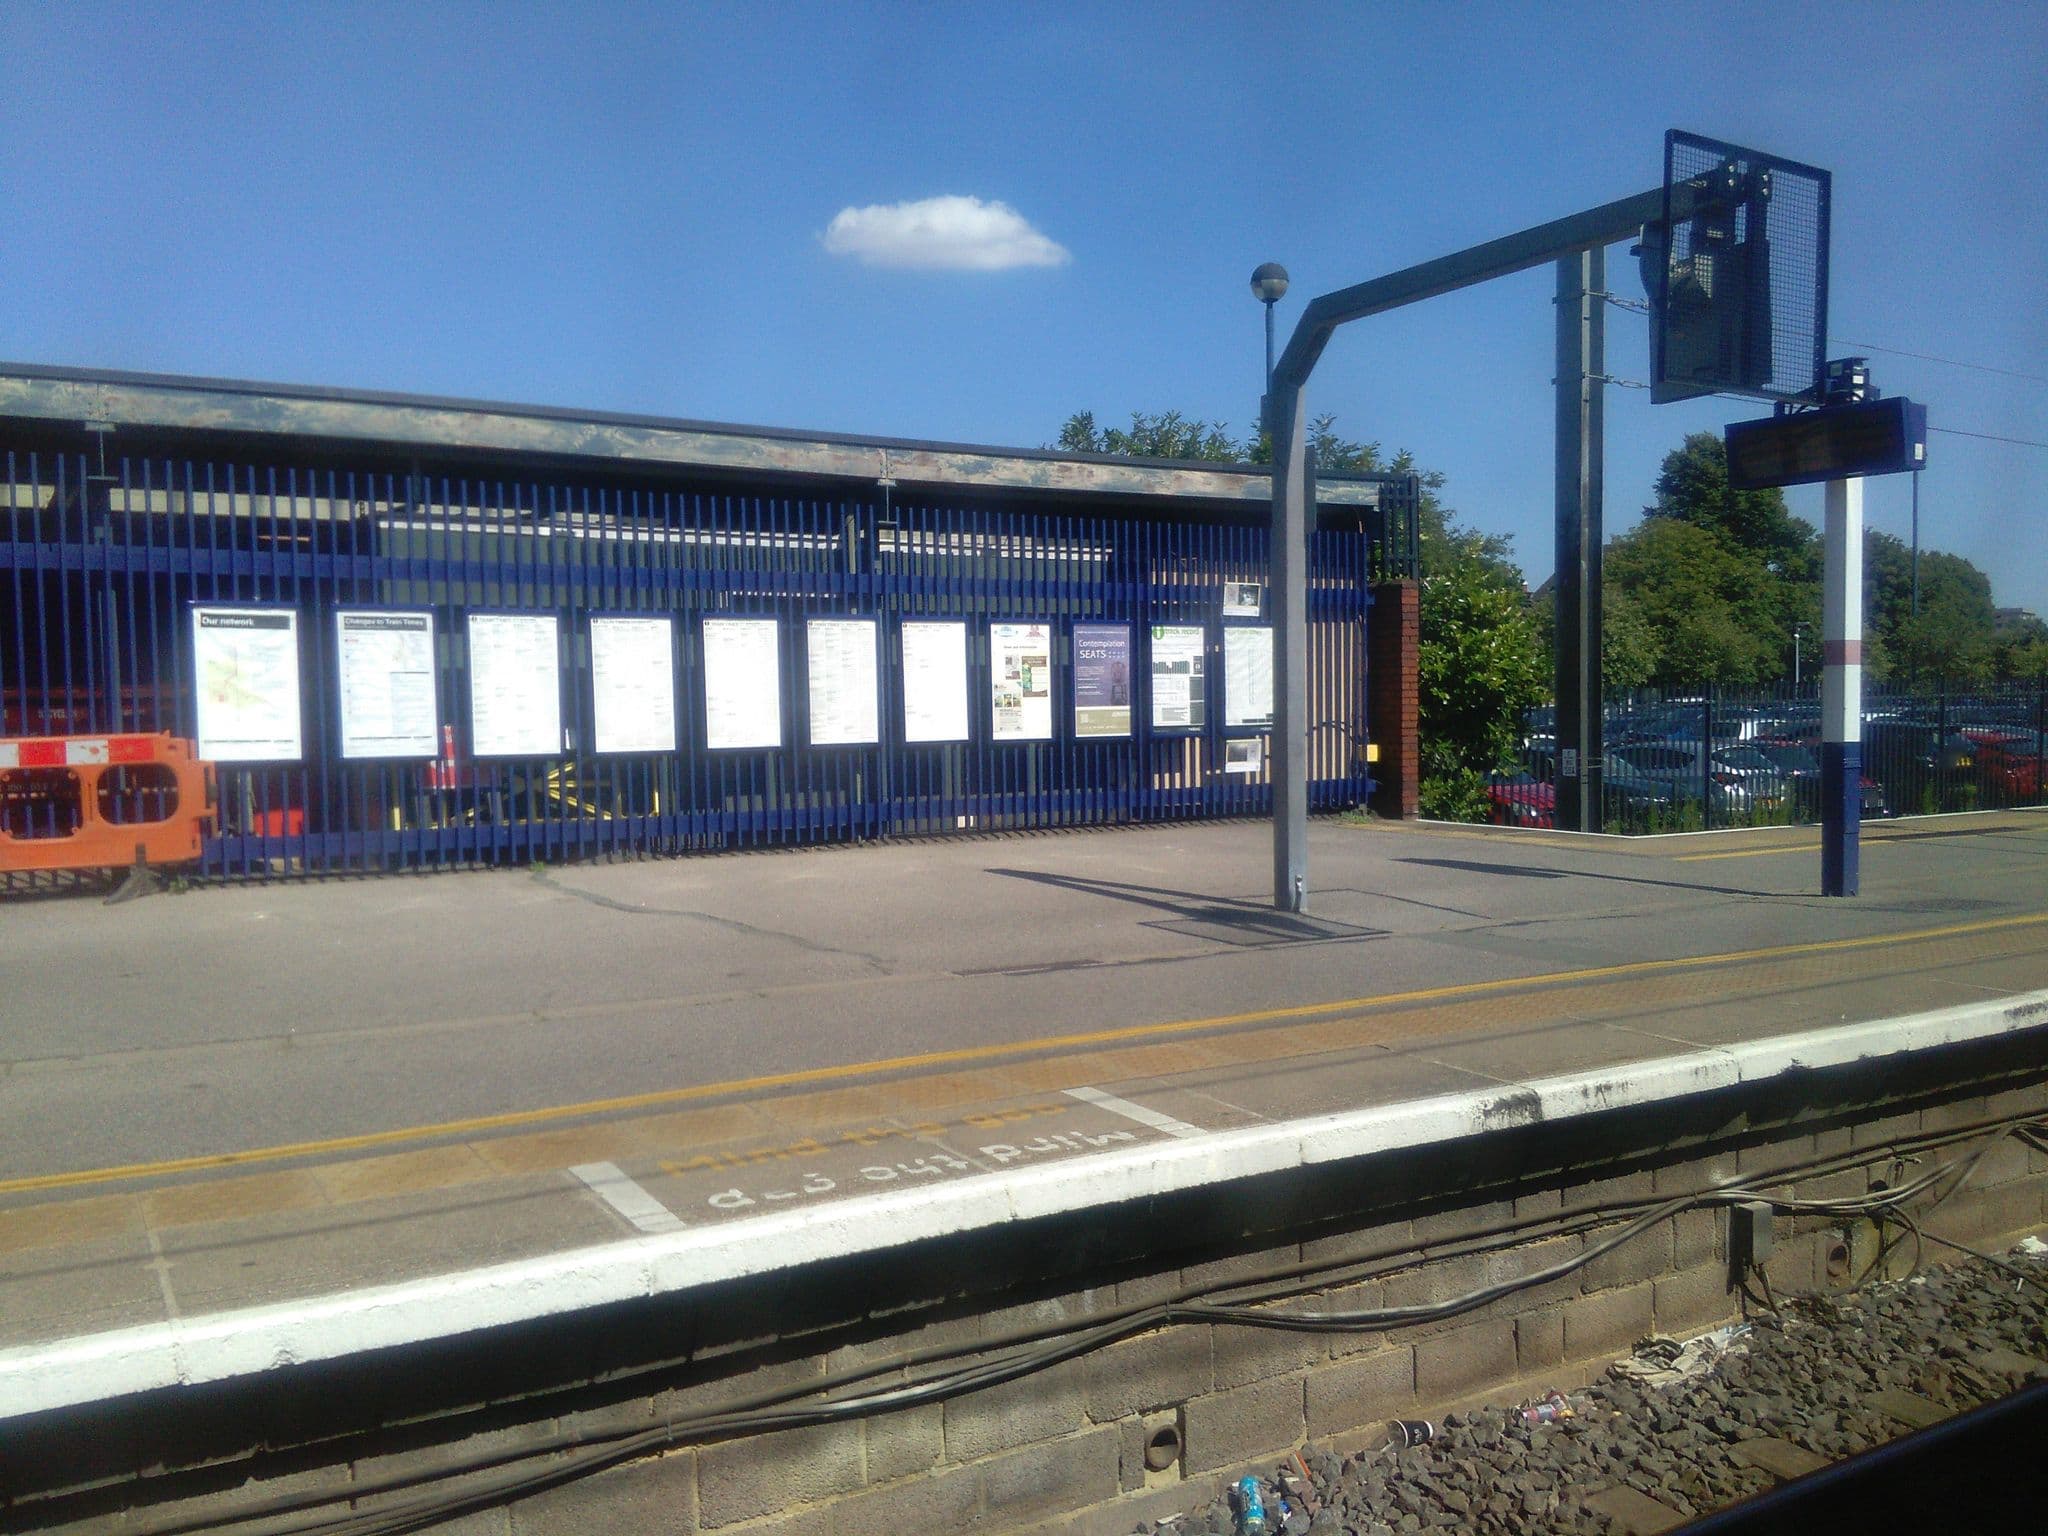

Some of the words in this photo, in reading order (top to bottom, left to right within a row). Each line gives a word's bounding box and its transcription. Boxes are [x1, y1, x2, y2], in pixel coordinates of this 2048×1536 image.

[202, 616, 217, 625] Our
[220, 617, 254, 626] network
[1078, 640, 1125, 649] Contemplation
[1079, 650, 1106, 659] SEATS
[979, 1130, 1137, 1163] Mind
[860, 1155, 969, 1184] the
